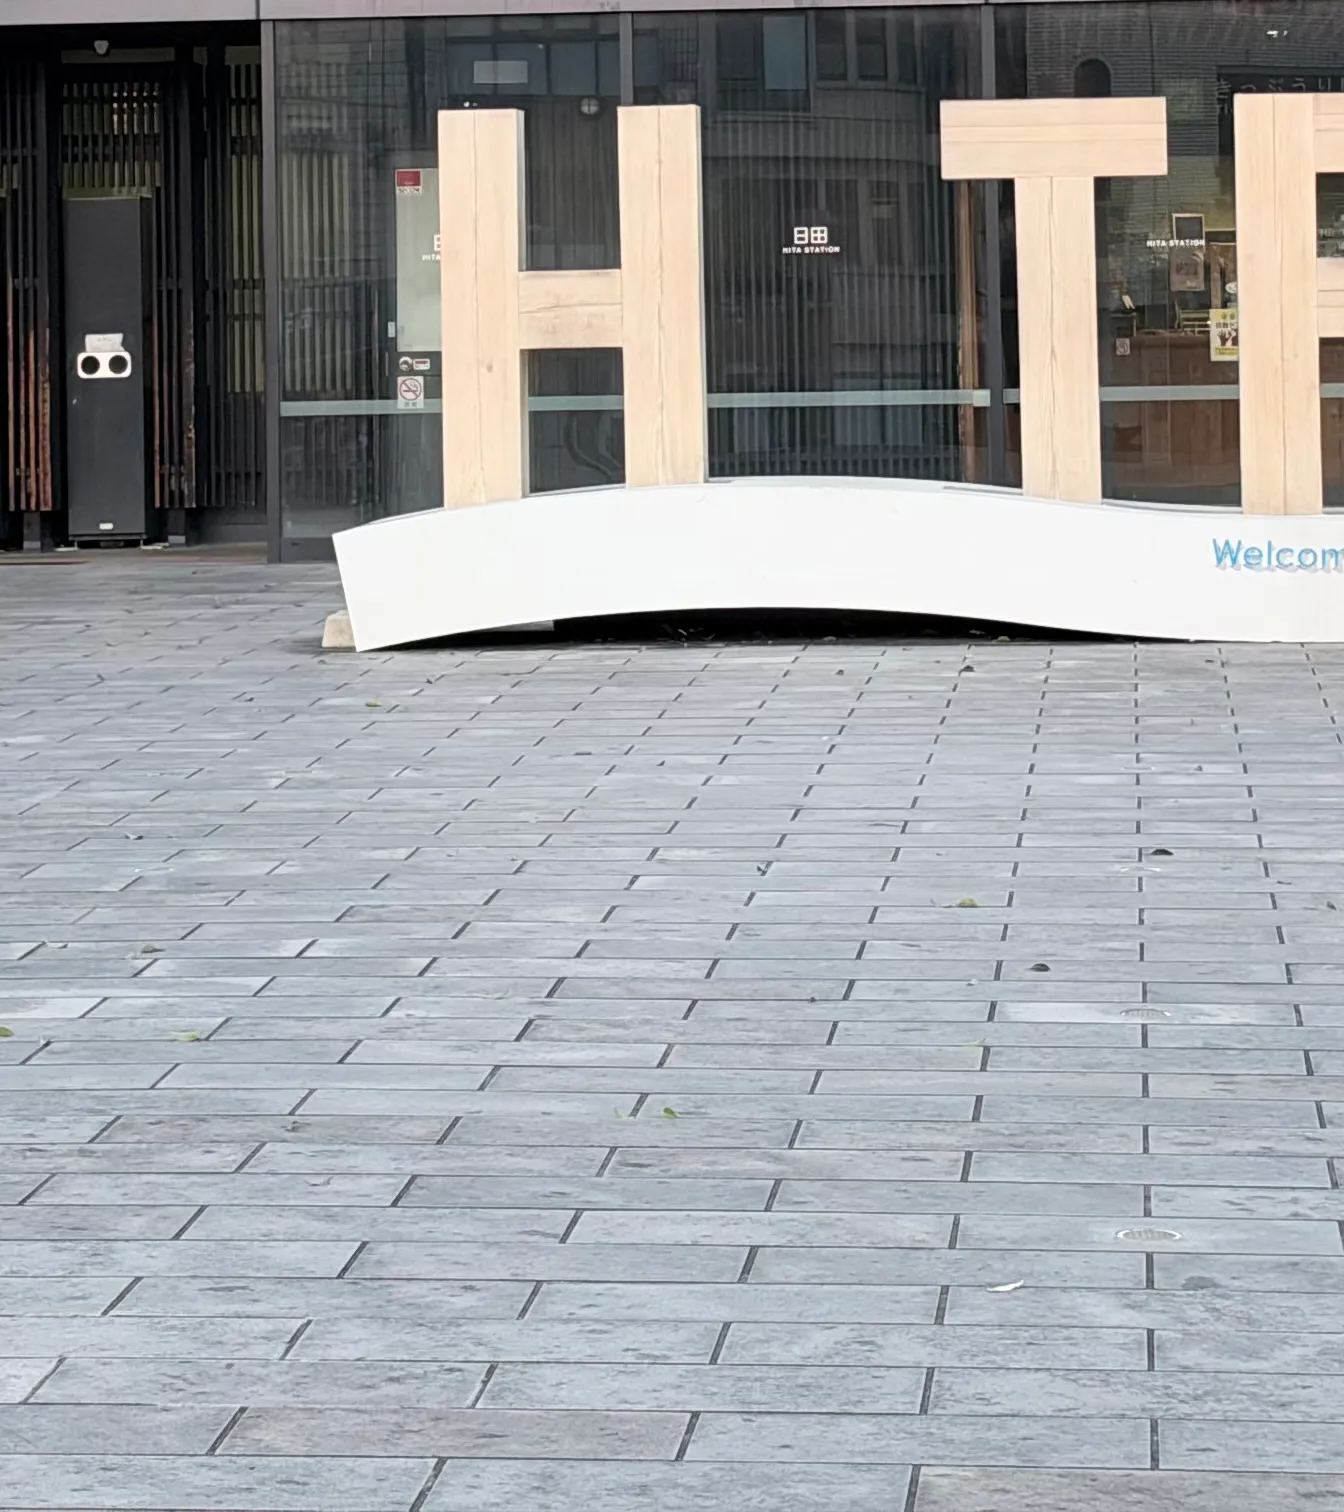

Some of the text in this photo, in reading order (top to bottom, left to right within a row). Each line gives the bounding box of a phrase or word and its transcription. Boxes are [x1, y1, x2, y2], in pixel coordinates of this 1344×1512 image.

[793, 226, 828, 245] 日田
[1146, 239, 1206, 248] HITA STATION
[782, 245, 841, 255] HITA STATION
